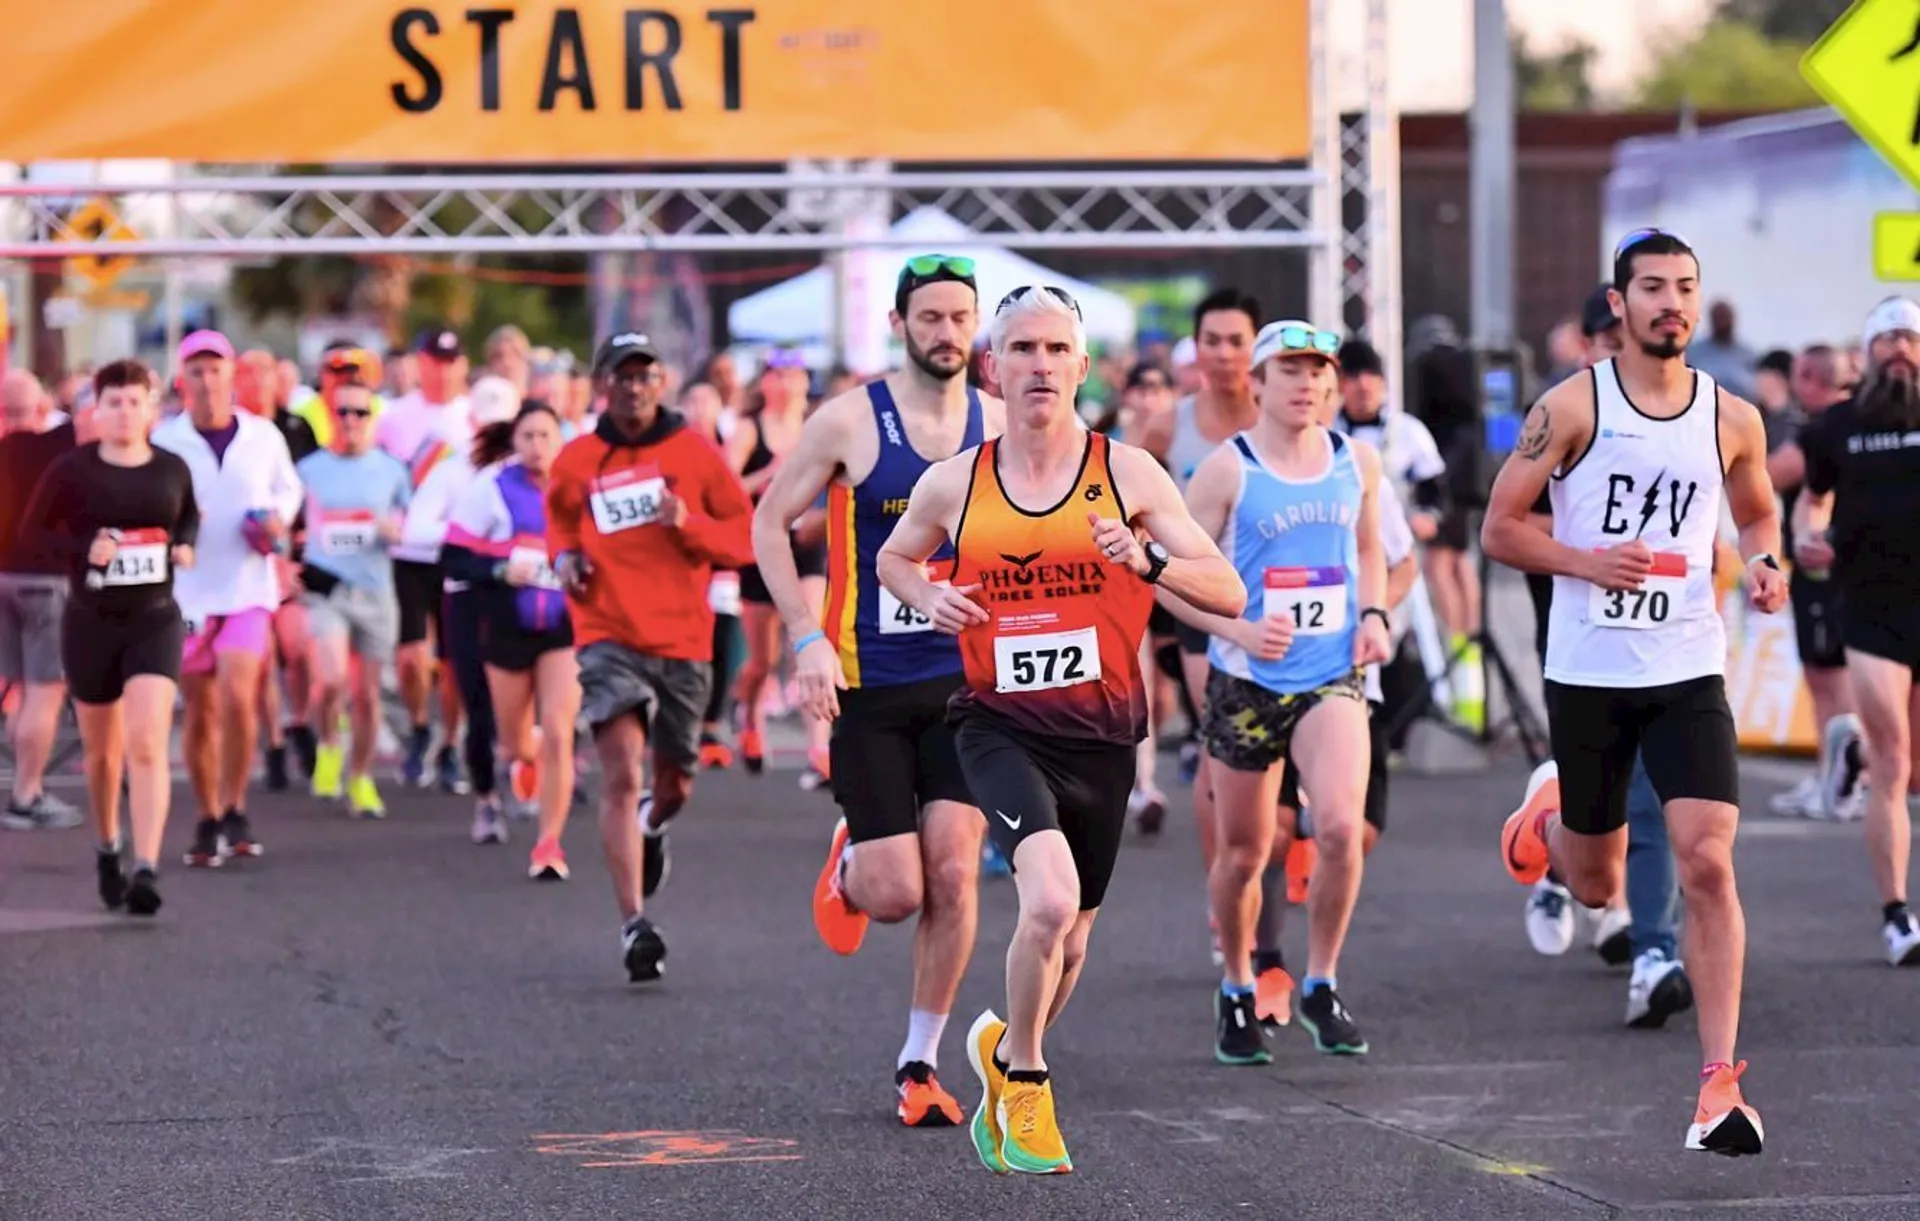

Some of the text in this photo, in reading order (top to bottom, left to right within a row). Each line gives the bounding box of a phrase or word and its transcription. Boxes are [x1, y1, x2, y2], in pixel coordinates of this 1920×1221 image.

[390, 9, 755, 112] START
[881, 410, 902, 446] soar
[606, 493, 654, 524] 538
[979, 561, 1106, 591] PHOENIX
[1290, 601, 1325, 629] 12
[1604, 587, 1669, 622] 370
[1012, 645, 1085, 685] 572
